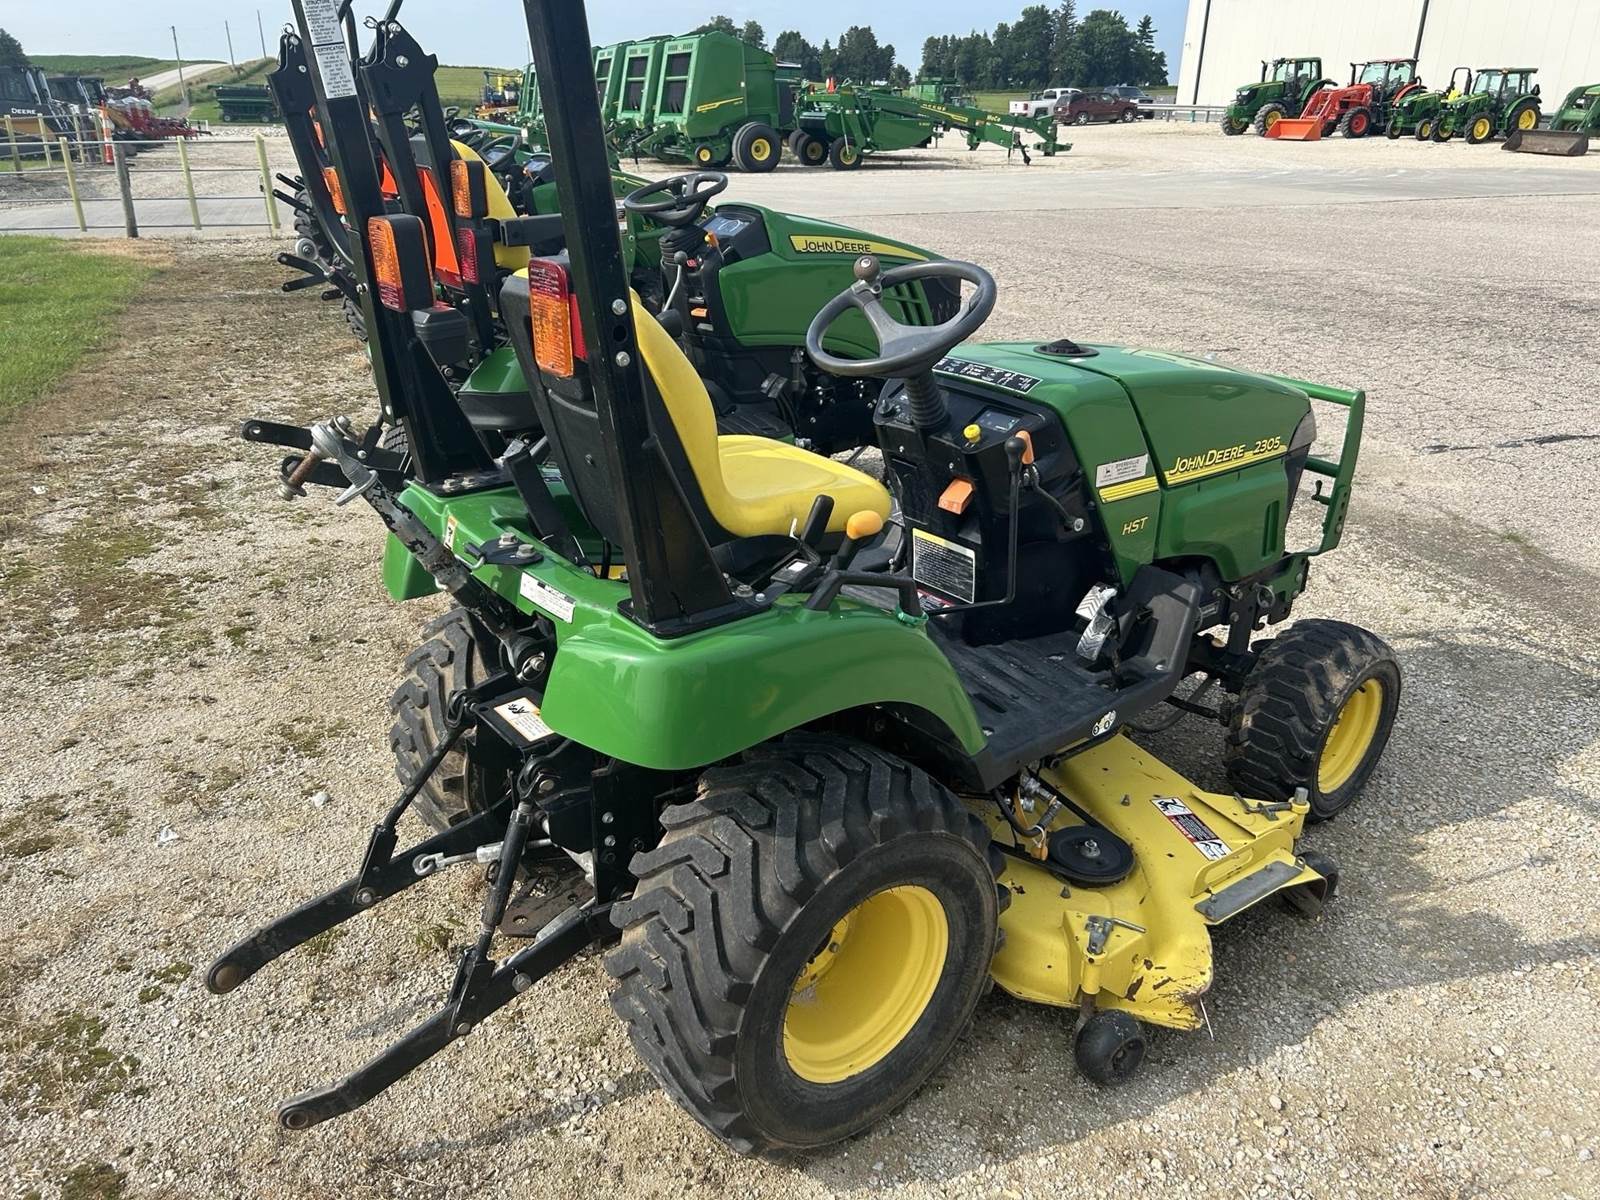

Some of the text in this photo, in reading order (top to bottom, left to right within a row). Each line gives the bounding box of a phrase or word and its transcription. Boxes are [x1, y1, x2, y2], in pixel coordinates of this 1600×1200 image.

[802, 240, 872, 252] JOHN DEERE
[1169, 436, 1281, 474] JOHN DEERE 2305
[1122, 516, 1149, 536] HST
